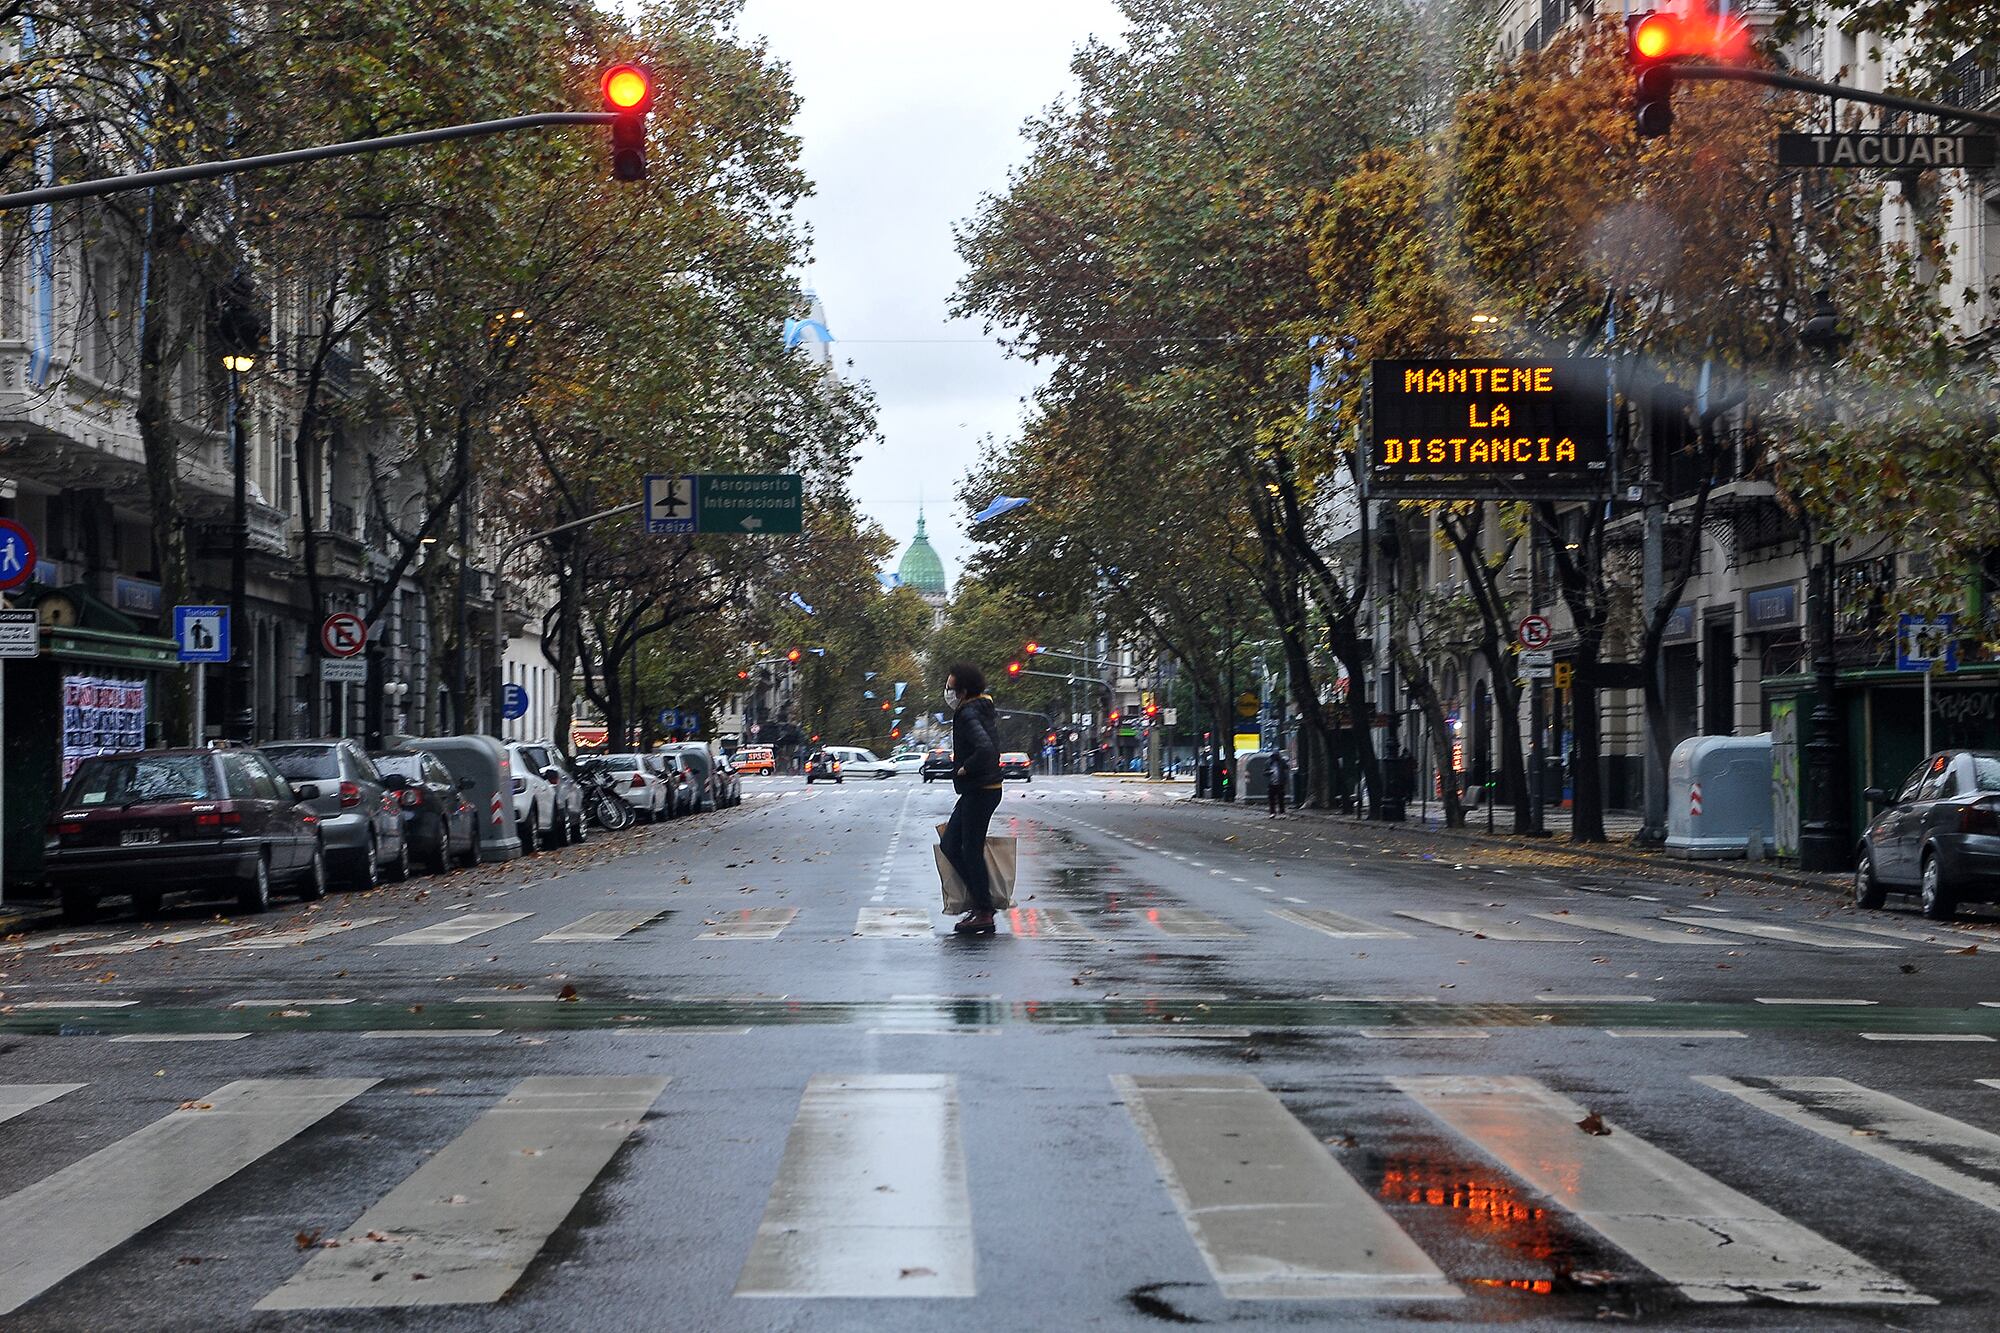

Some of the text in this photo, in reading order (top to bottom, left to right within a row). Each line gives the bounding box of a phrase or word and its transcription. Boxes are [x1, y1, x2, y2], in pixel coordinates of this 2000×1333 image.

[1810, 135, 1965, 165] TACUARI
[1404, 367, 1553, 393] MANTENE
[1469, 403, 1511, 428] LA
[1384, 437, 1576, 463] DISTANCIA
[709, 478, 790, 492] Aeropuerto
[704, 496, 796, 509] Internacional
[649, 521, 694, 533] Ezeiza
[504, 686, 518, 705] E
